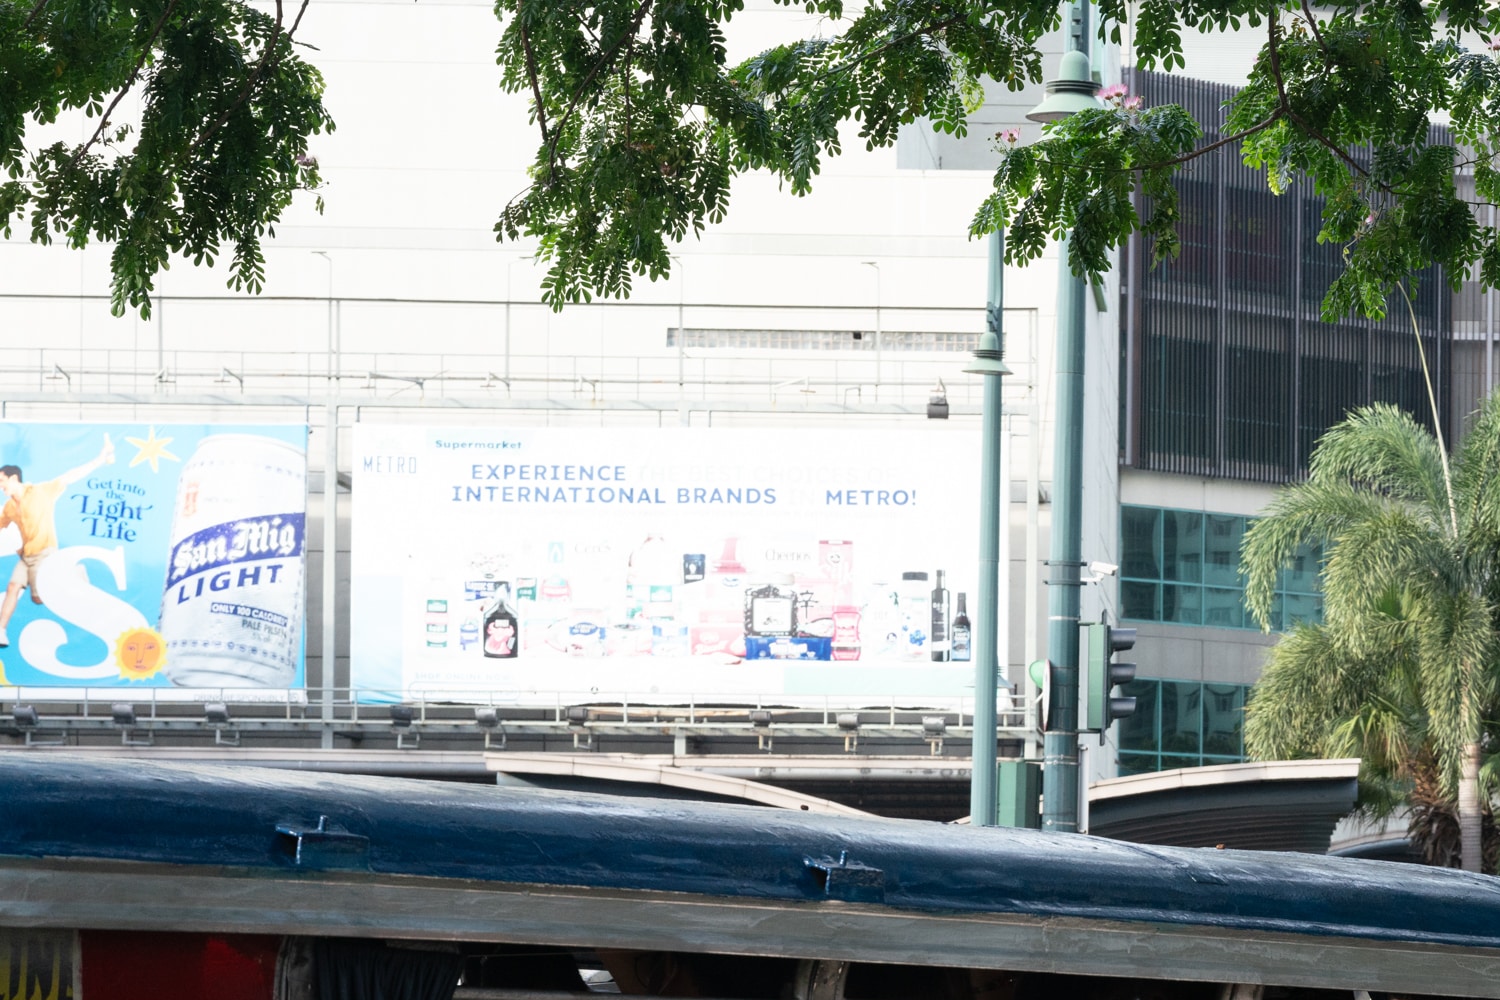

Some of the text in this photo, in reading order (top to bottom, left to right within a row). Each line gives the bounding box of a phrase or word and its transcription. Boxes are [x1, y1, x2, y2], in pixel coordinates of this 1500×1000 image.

[435, 439, 523, 450] Supermarket
[363, 456, 417, 474] METRO
[471, 464, 627, 481] EXPERIENCE
[87, 478, 146, 496] Get into
[106, 490, 125, 500] the
[452, 486, 667, 503] INTERNATIONAL
[676, 488, 777, 504] BRANDS
[826, 490, 917, 506] METRO!
[70, 494, 153, 524] Light
[81, 517, 137, 542] Life
[171, 516, 297, 580] San Mig
[177, 564, 284, 605] LIGHT
[18, 544, 156, 680] S
[211, 603, 235, 614] ONLY
[241, 618, 262, 631] PALE
